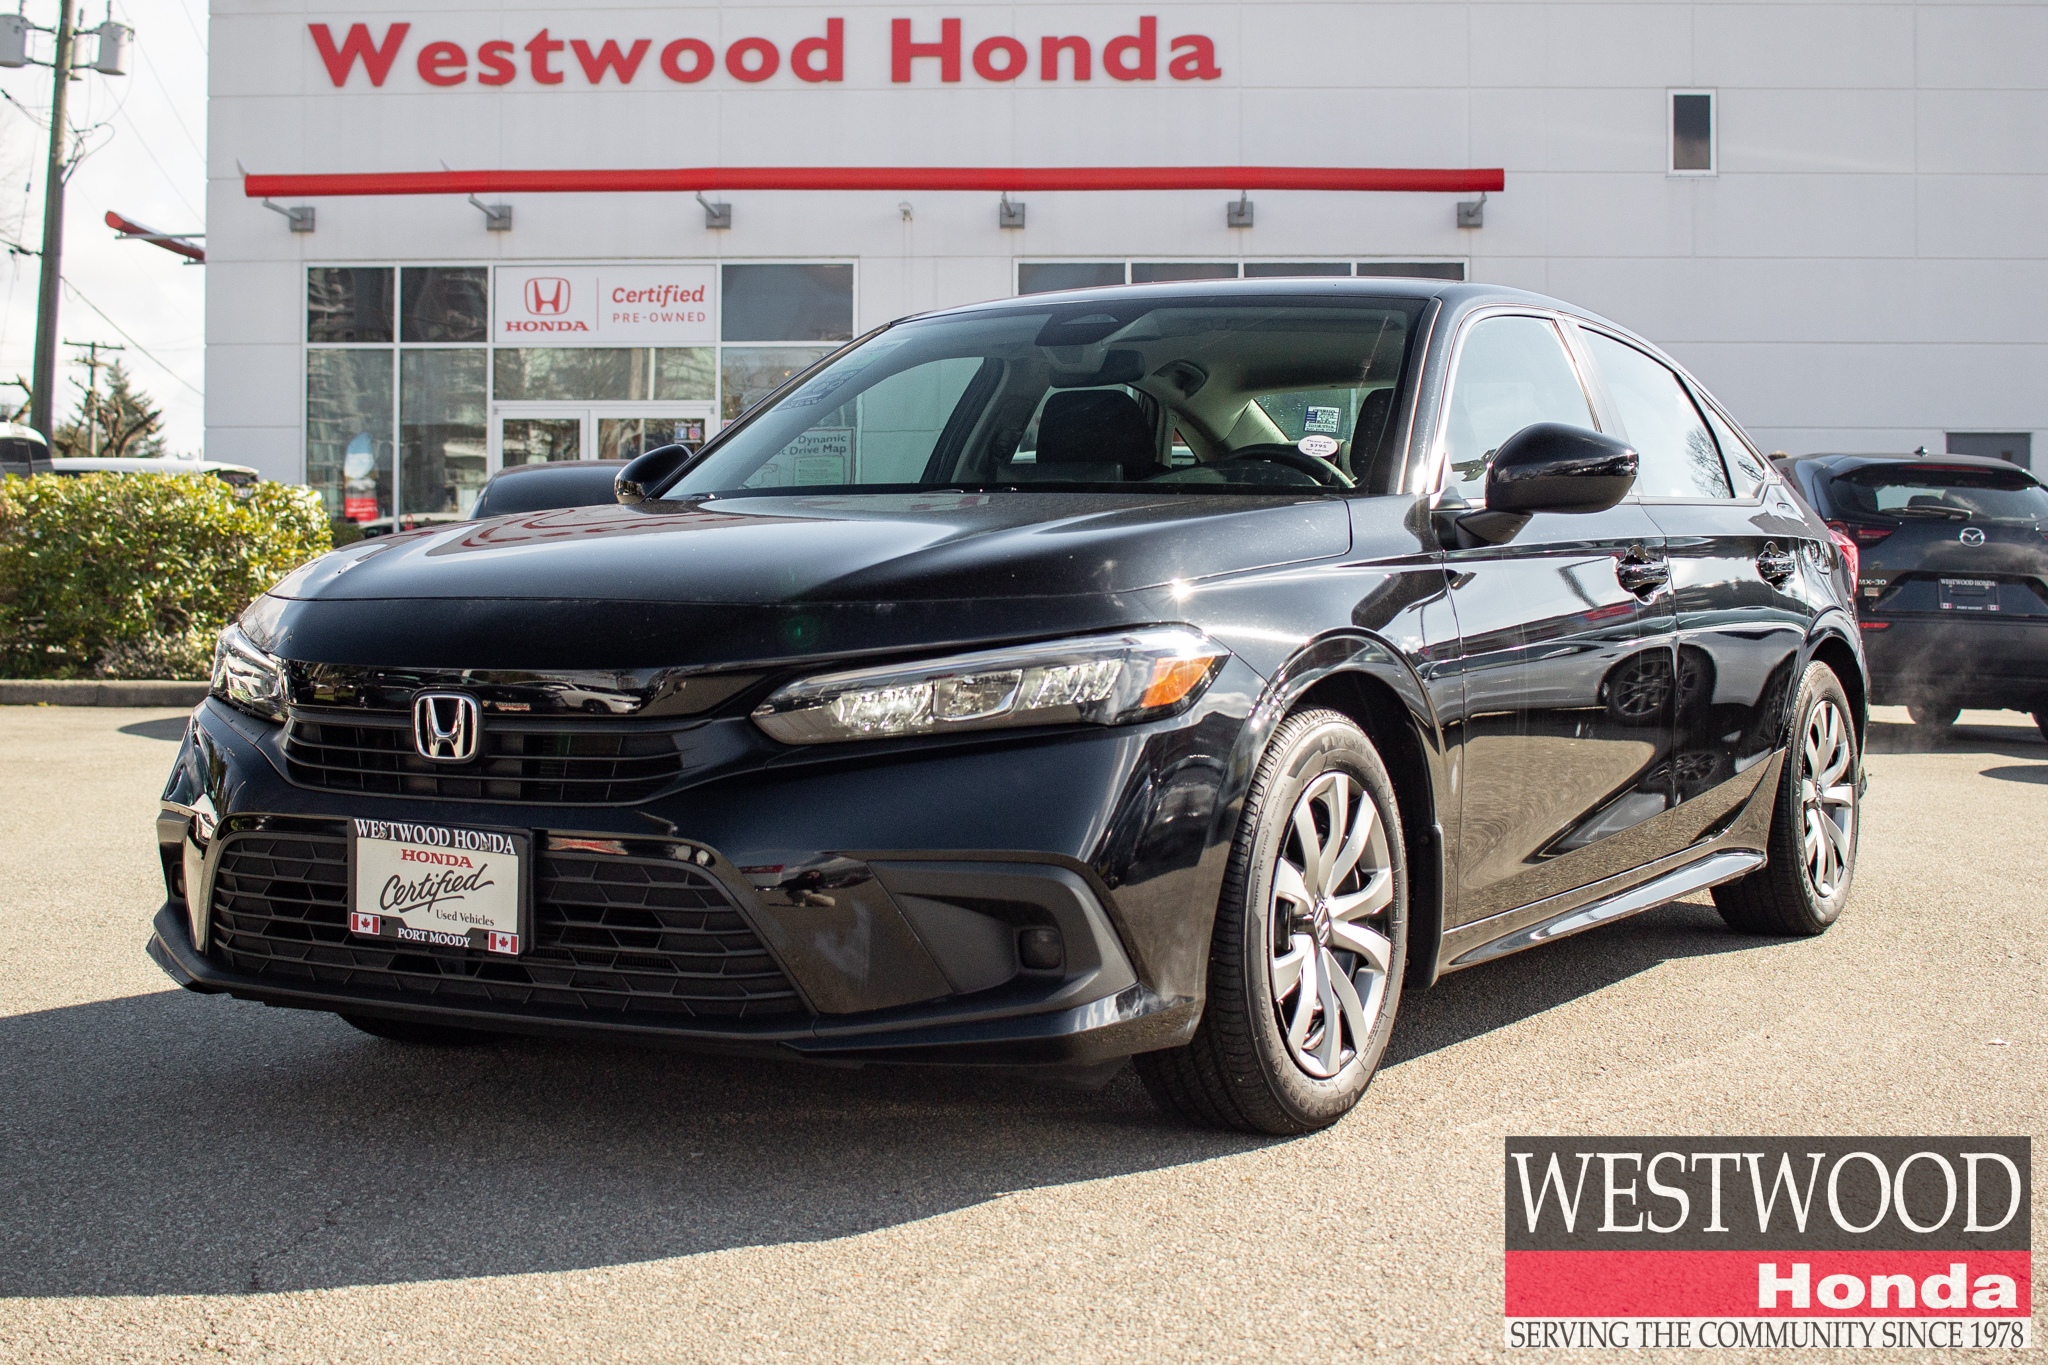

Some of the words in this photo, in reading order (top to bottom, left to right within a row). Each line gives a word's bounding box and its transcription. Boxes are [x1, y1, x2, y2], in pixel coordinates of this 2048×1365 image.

[308, 17, 844, 87] Westwood
[891, 16, 1222, 83] Honda
[612, 284, 705, 307] Certified
[505, 320, 589, 332] HONDA
[612, 311, 706, 323] PRE-OWNED
[798, 434, 847, 446] Dynamic
[789, 446, 819, 455] Drive
[822, 443, 847, 456] Map
[1858, 578, 1887, 586] MX-30
[1940, 578, 1974, 586] WESTWOOD
[354, 818, 450, 847] WESTWOOD
[454, 829, 516, 855] HONDA
[401, 848, 474, 869] HONDA
[379, 863, 495, 912] Certified
[436, 909, 458, 922] Used
[459, 912, 495, 927] Vehicles
[397, 927, 428, 942] PORT
[429, 930, 471, 948] MOODY
